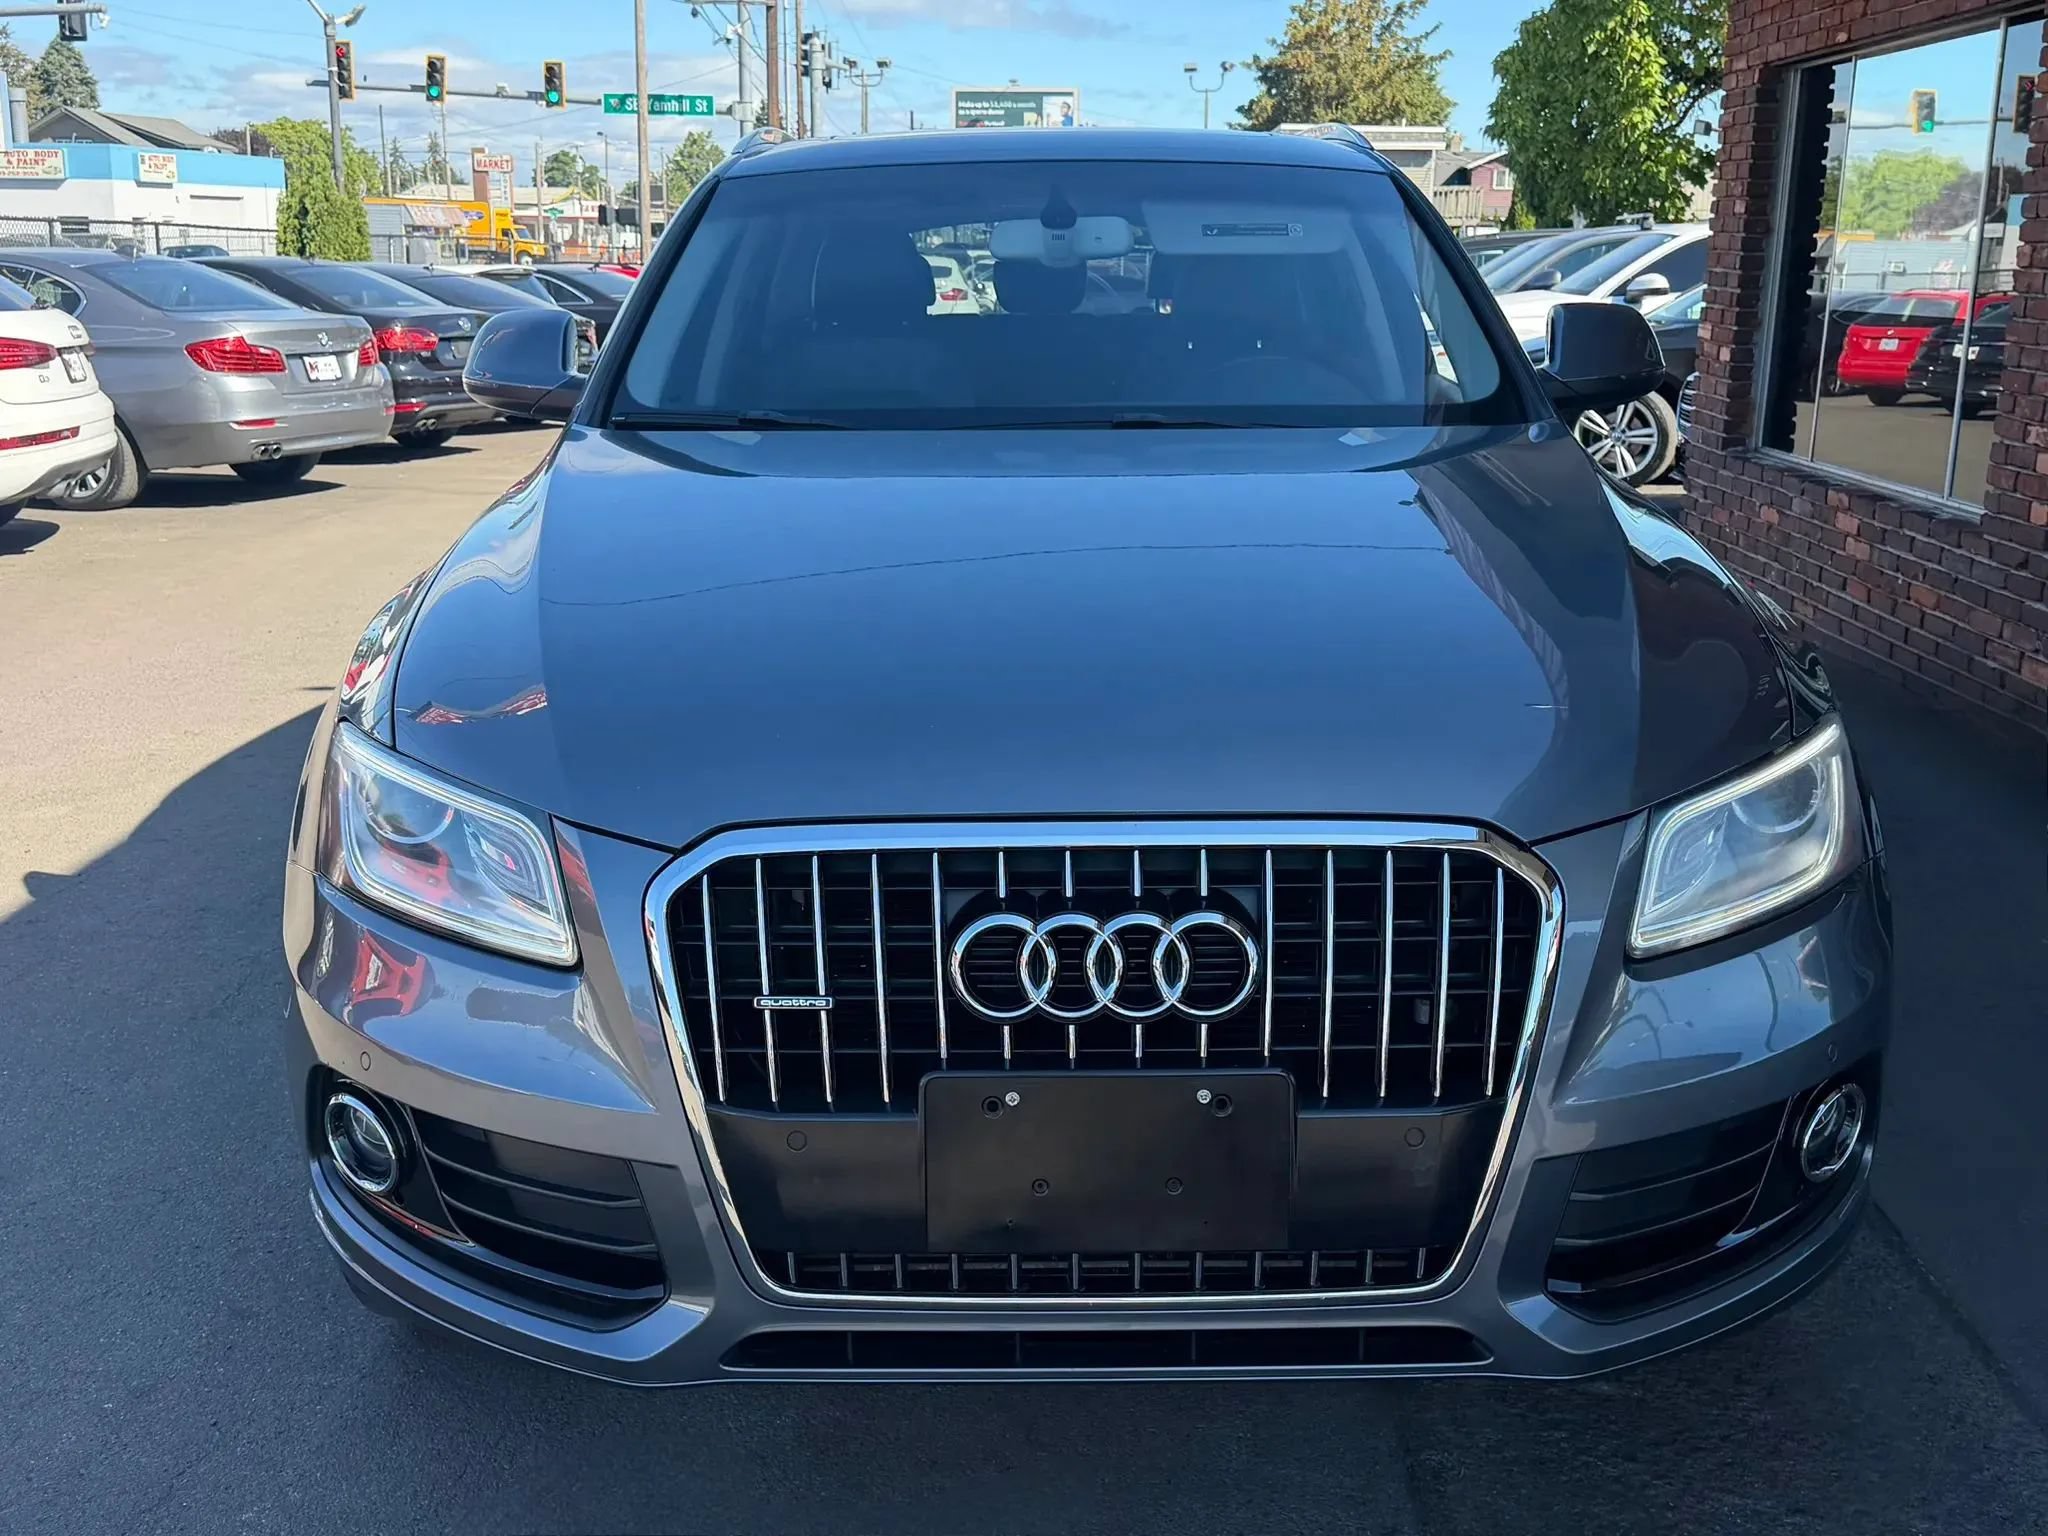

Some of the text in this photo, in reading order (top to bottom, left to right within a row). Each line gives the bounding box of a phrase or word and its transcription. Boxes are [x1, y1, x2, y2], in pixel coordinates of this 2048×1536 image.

[695, 99, 708, 113] St
[34, 150, 59, 158] BODY
[476, 159, 510, 170] MARKET
[760, 999, 826, 1007] quattro
